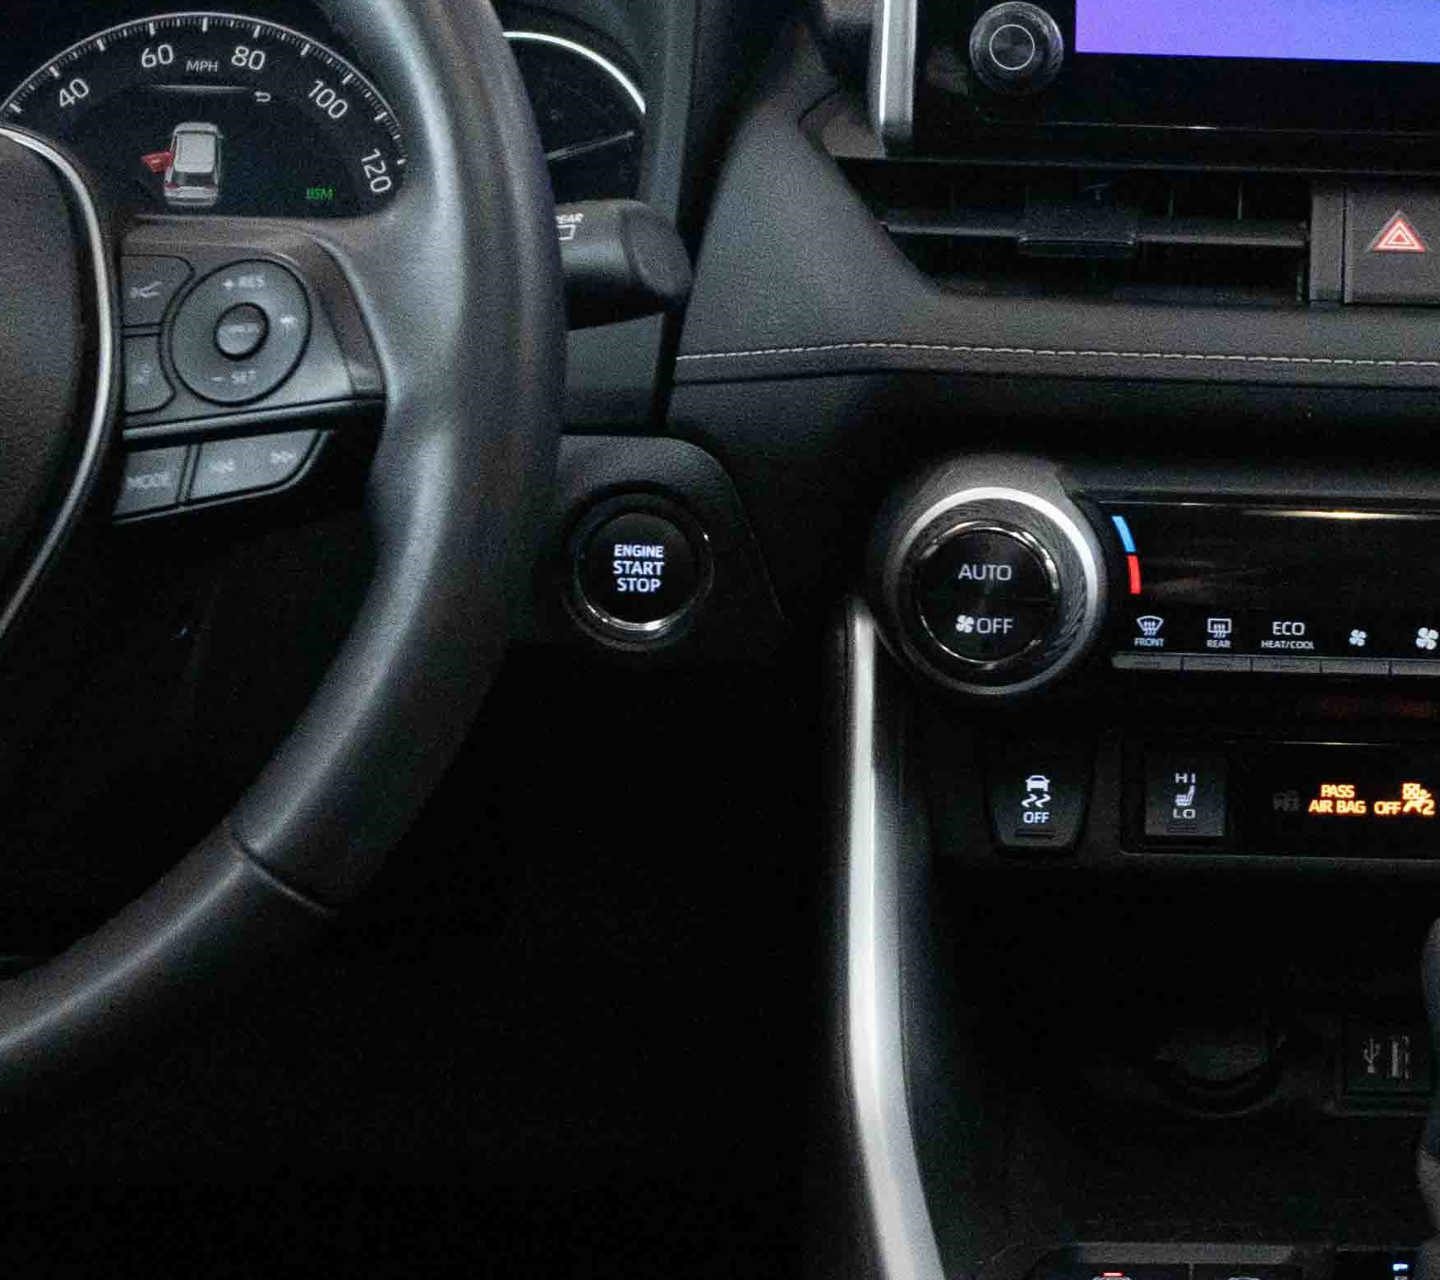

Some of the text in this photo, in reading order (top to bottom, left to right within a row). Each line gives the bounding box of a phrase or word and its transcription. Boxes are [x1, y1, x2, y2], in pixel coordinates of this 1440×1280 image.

[141, 43, 174, 69] 60
[231, 46, 265, 71] 80
[186, 59, 219, 72] MPH
[58, 77, 90, 108] 40
[308, 79, 348, 120] 100
[360, 147, 393, 195] 120
[613, 544, 665, 559] ENGINE
[613, 561, 665, 576] START
[958, 564, 1013, 582] AUTO
[616, 577, 661, 593] STOP
[976, 617, 1013, 635] OFF
[1271, 621, 1305, 637] ECO
[1134, 638, 1164, 648] FRONT
[1206, 639, 1231, 649] REAR
[1260, 640, 1315, 650] HEAT/COOL
[1174, 773, 1197, 783] HI
[1320, 784, 1356, 799] PASS
[1172, 808, 1196, 820] LO
[1308, 799, 1335, 813] AIR
[1336, 800, 1367, 815] BAG
[1373, 800, 1402, 816] OFF
[1022, 811, 1050, 825] OFF
